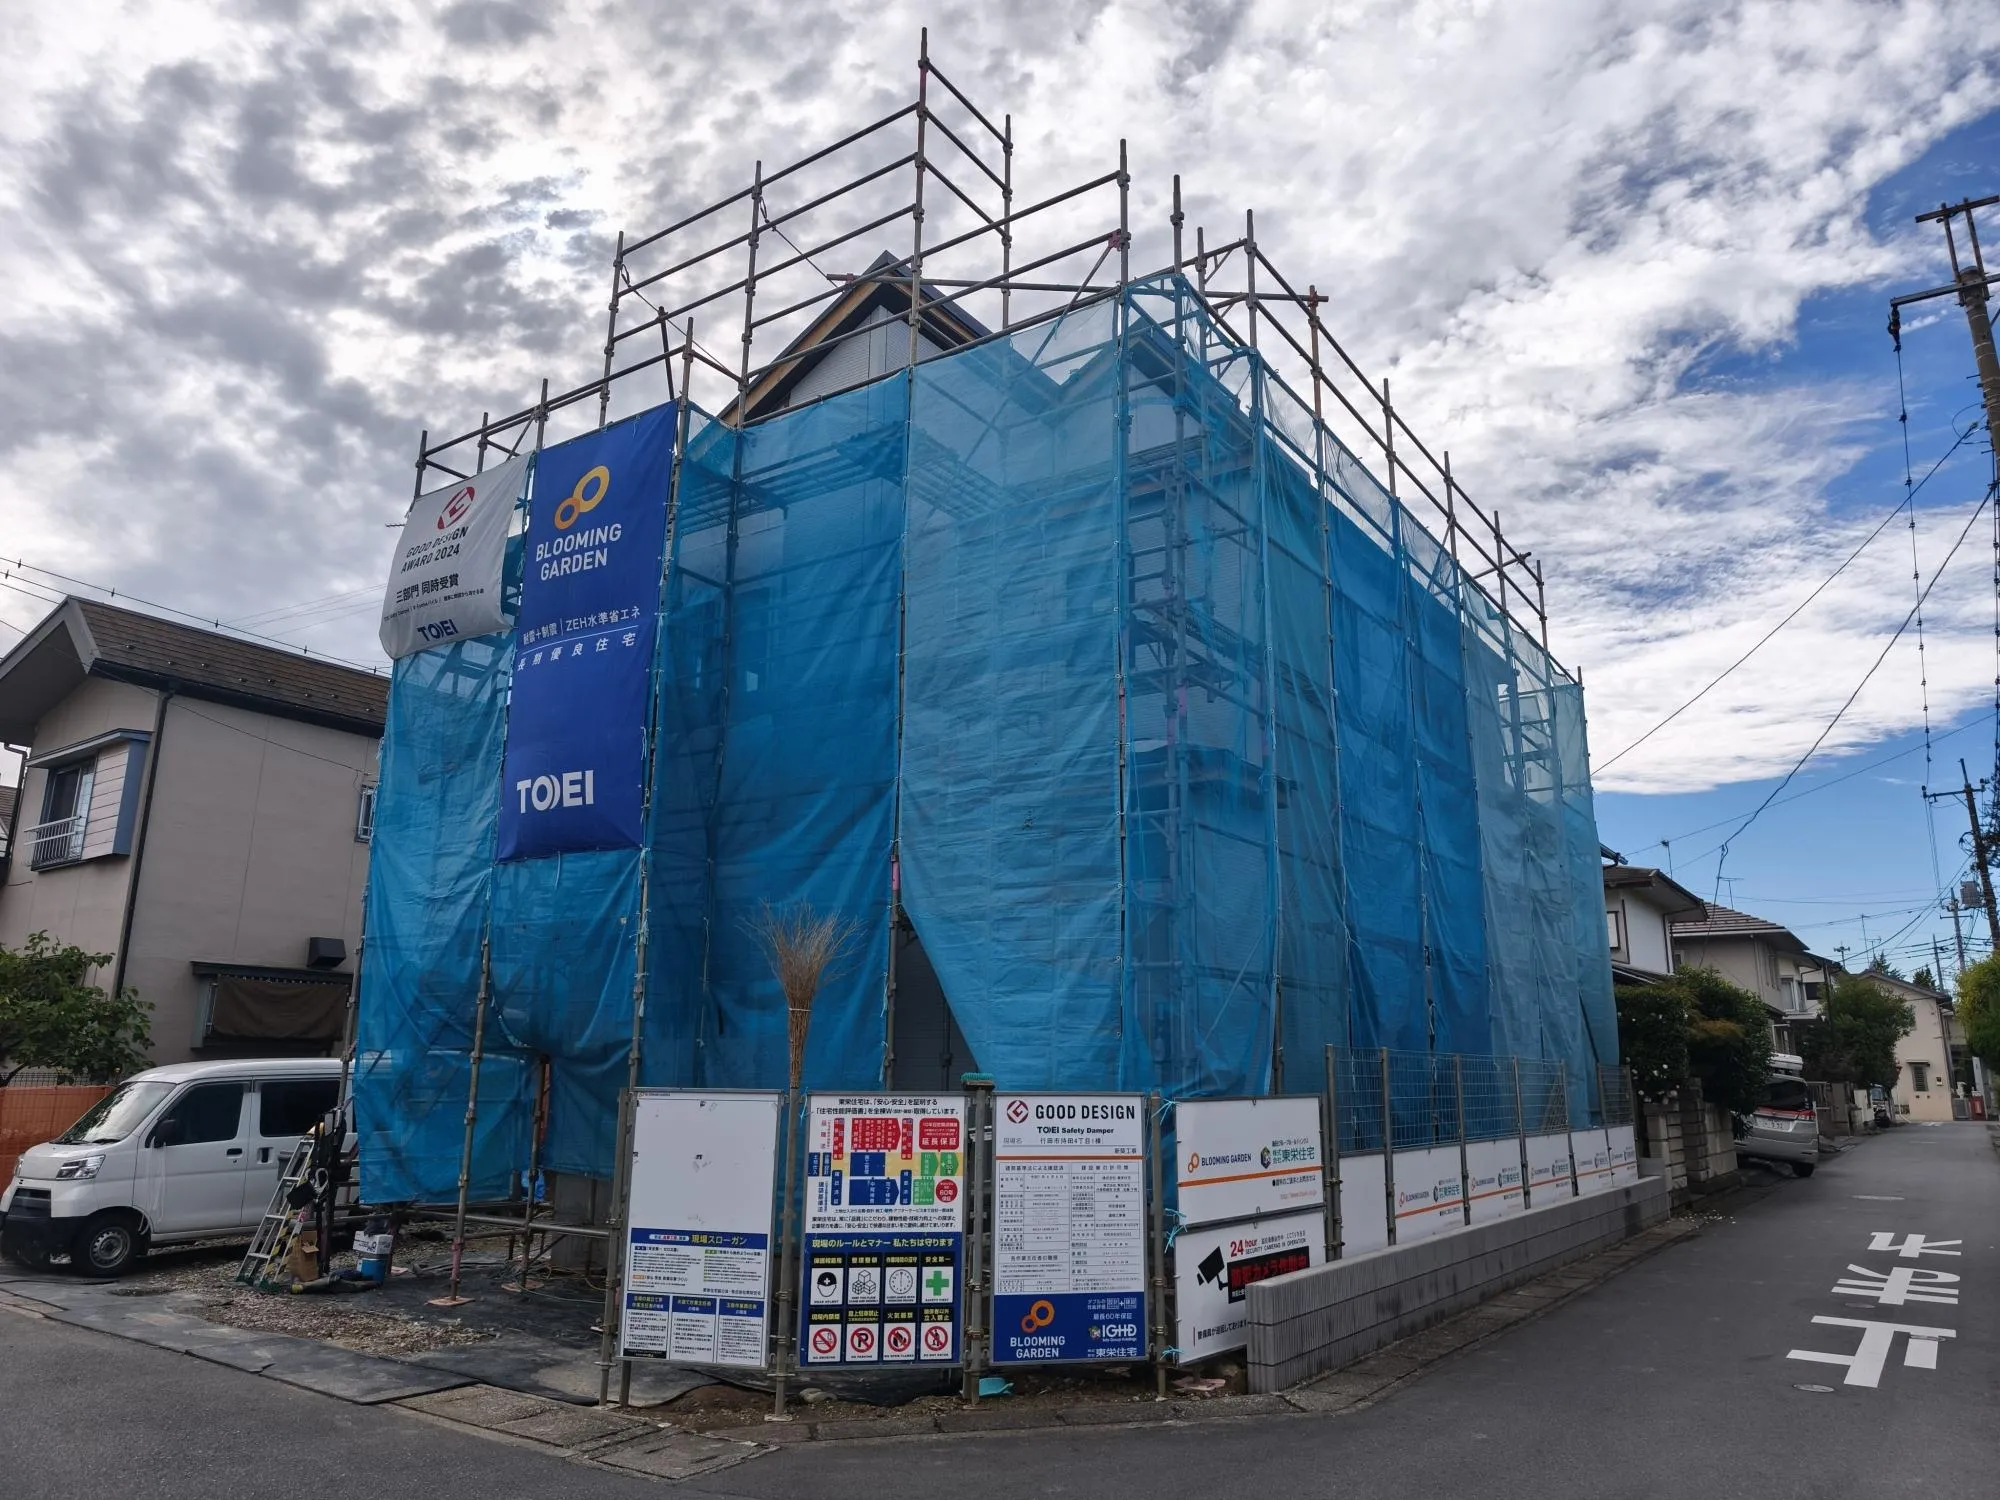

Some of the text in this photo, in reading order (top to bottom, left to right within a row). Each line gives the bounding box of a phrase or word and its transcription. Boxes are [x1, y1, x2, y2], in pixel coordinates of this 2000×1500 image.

[406, 526, 469, 559] GOOD DESIGN
[535, 523, 622, 562] BLOOMING
[401, 543, 460, 574] AWARD 2024
[540, 547, 608, 581] GARDEN
[396, 573, 459, 603] 三部門 同時受賞
[565, 605, 641, 631] ZEH水準省エネ
[417, 618, 459, 642] TOEI
[516, 769, 594, 814] TOEI
[1035, 1104, 1135, 1120] GOOD DESIGN
[1036, 1126, 1114, 1135] TOEI Safety Damper
[1201, 1153, 1252, 1166] BLOOMING GARDEN
[1282, 1146, 1315, 1162] 東栄住宅
[691, 1233, 748, 1246] 現場スローガン
[811, 1238, 954, 1248] 現場のルールとマナー 私たちは守ります
[1230, 1239, 1244, 1258] 24
[1244, 1239, 1258, 1248] hour
[925, 1255, 951, 1263] 安全第一
[1010, 1335, 1065, 1347] BLOOMING
[1016, 1347, 1059, 1359] GARDEN
[1096, 1347, 1138, 1358] 東栄住宅
